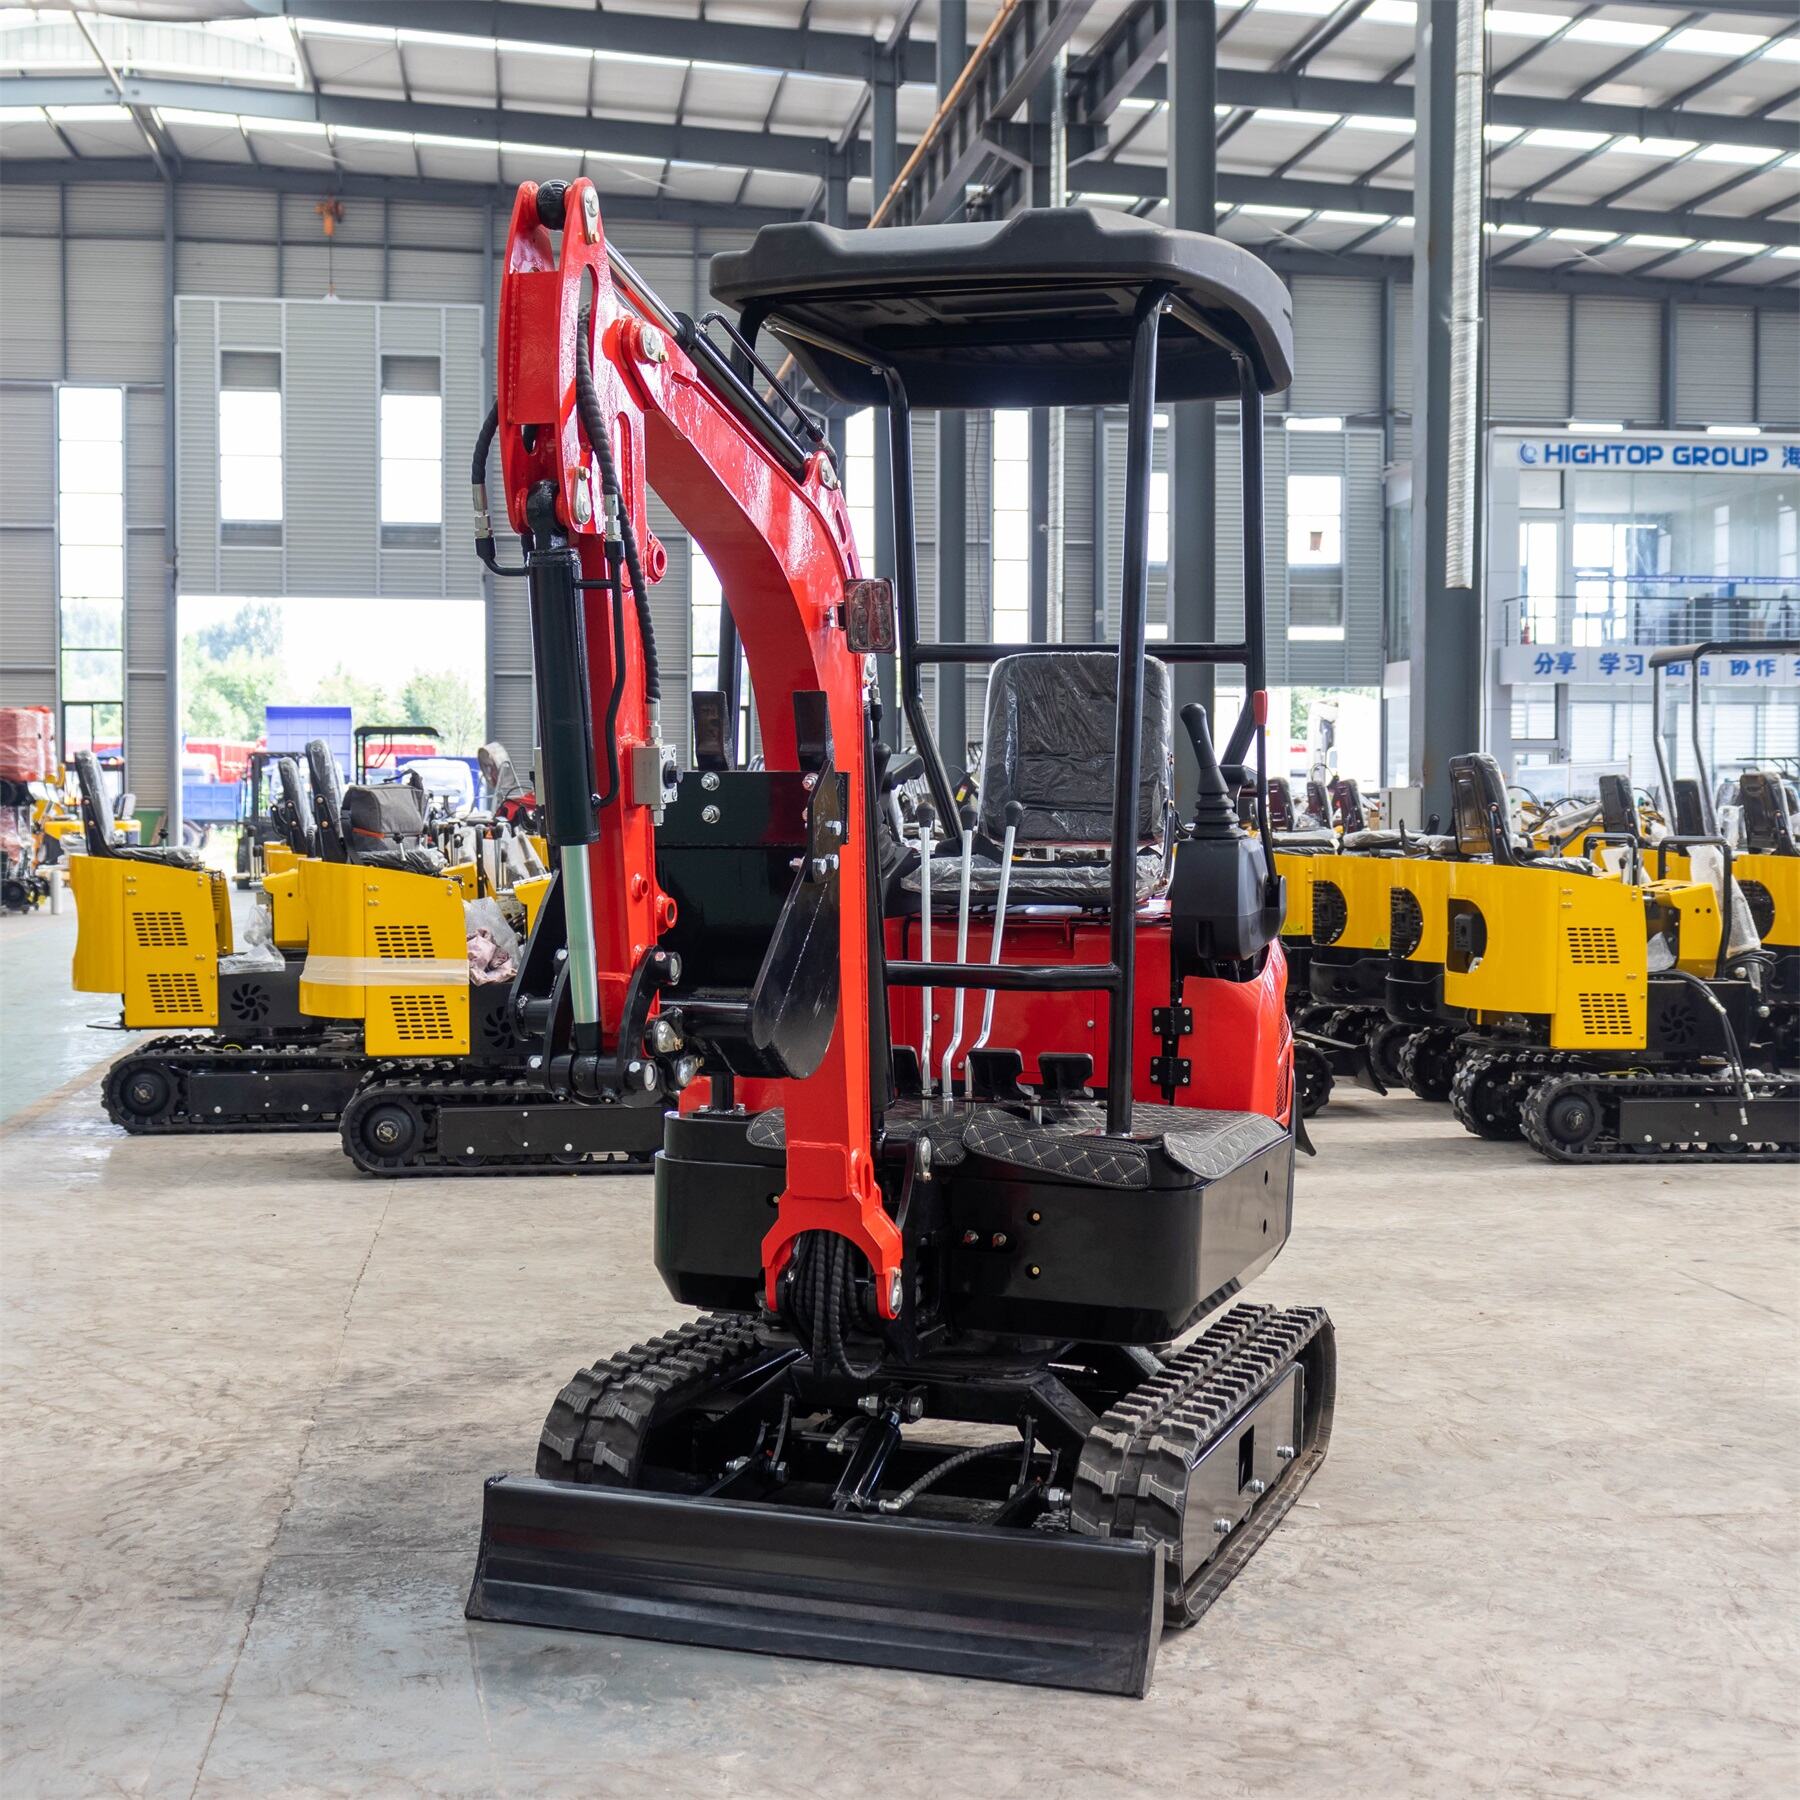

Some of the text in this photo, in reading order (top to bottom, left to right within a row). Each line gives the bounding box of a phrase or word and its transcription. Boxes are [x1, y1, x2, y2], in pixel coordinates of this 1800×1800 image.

[1544, 443, 1664, 465] HIGHTOP
[1672, 446, 1769, 467] GROUP
[1534, 651, 1577, 675] 分享
[1599, 652, 1645, 676] 学习
[1728, 658, 1776, 677] 协作
